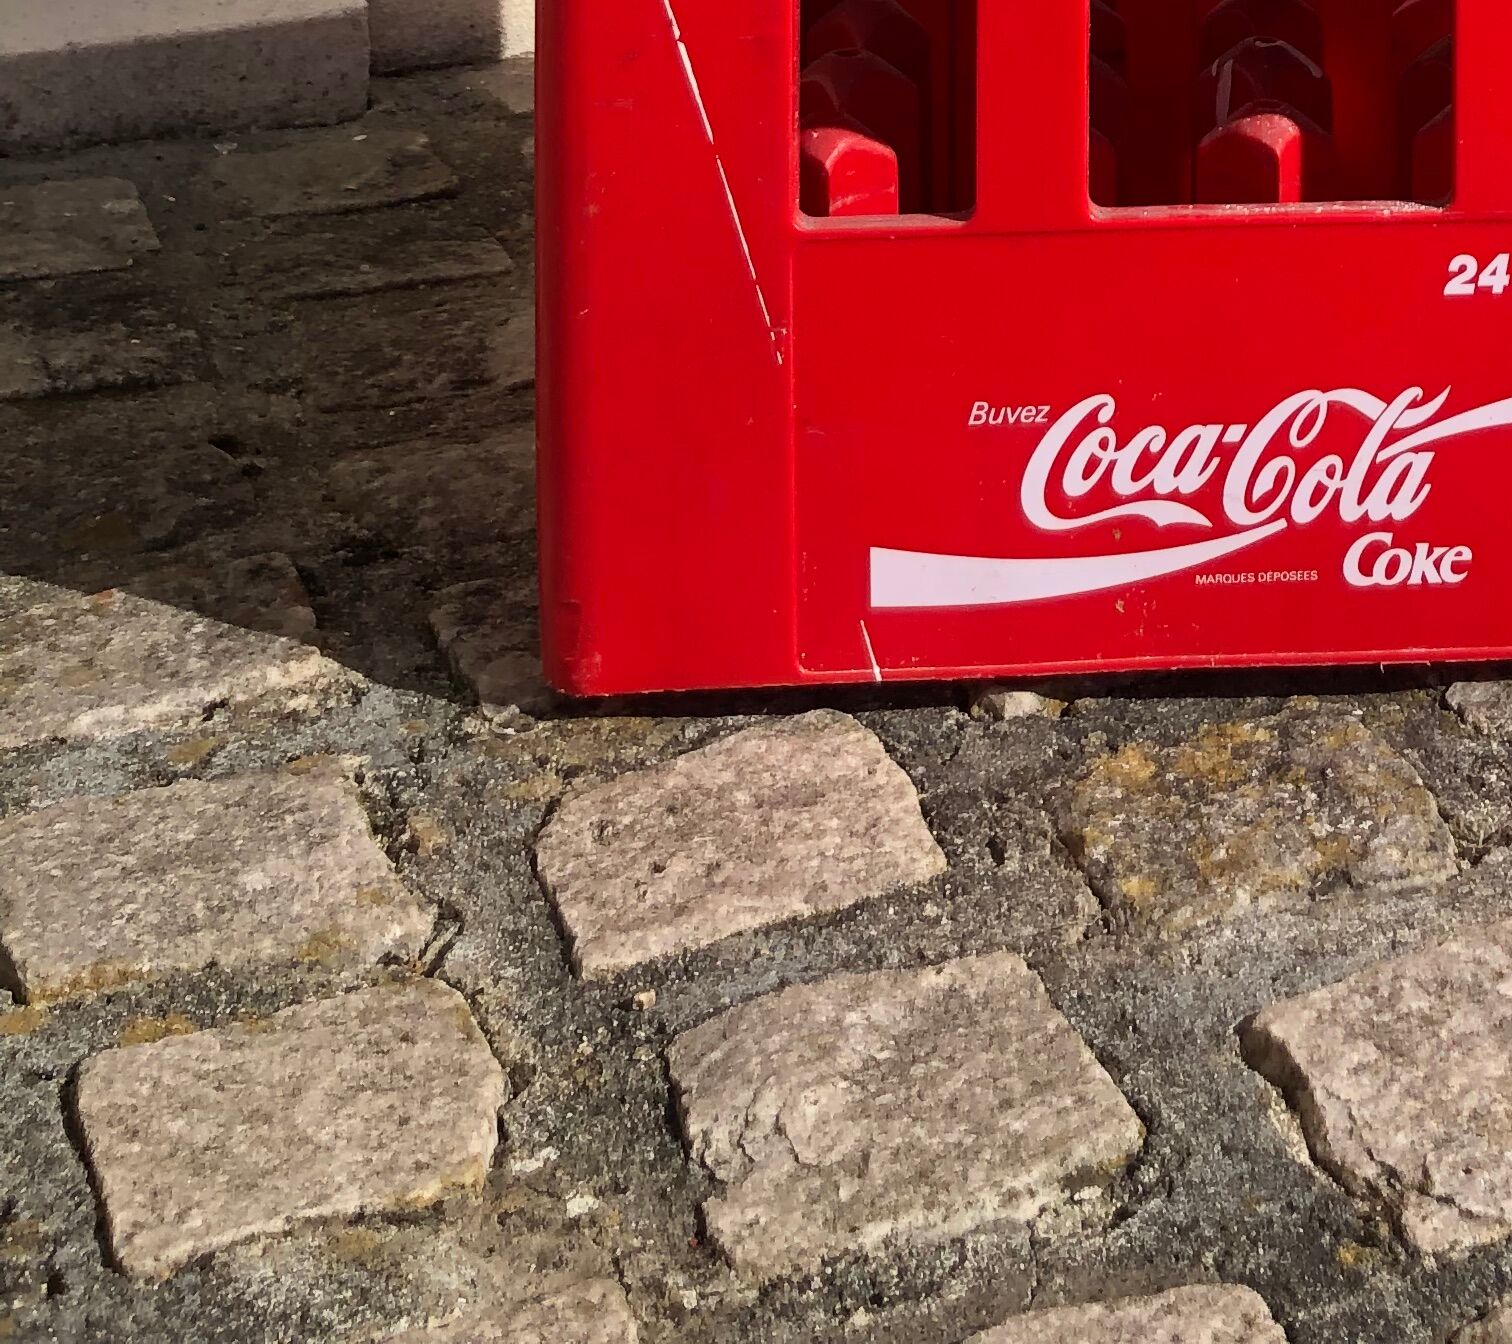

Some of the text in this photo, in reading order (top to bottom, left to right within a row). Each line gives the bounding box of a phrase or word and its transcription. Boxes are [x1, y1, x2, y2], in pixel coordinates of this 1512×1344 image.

[967, 385, 1452, 531] Buvez Coca-Cola
[1195, 572, 1256, 585] MARQUES
[1342, 531, 1473, 587] Coke
